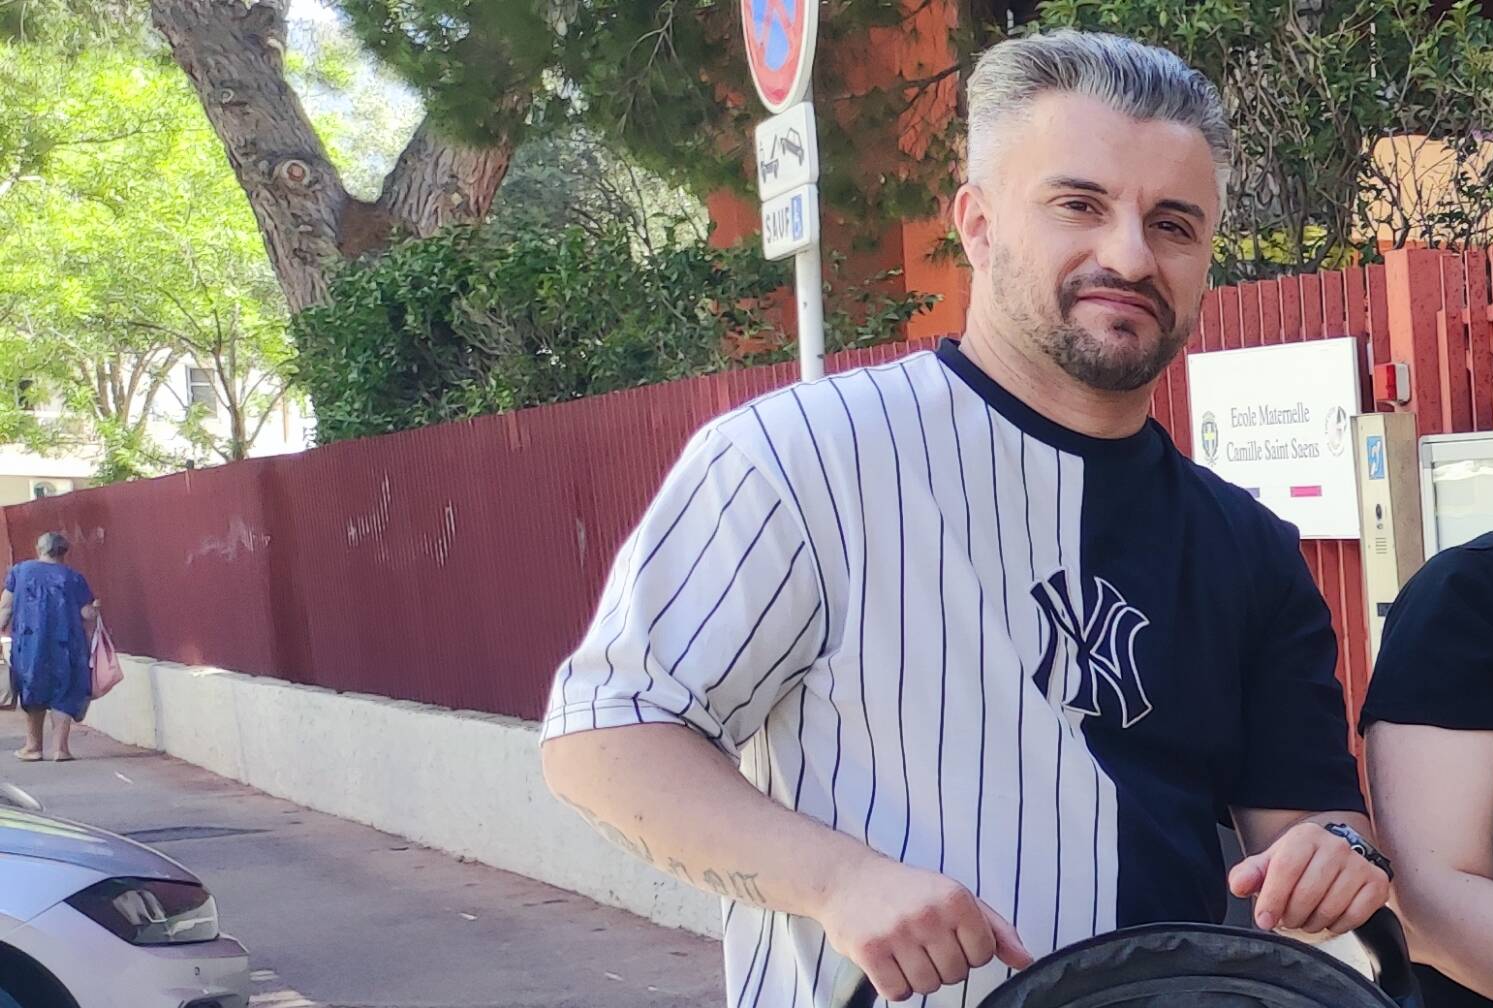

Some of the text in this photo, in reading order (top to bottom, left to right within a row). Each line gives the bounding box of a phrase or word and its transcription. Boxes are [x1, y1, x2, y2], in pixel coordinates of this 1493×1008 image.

[765, 207, 790, 243] SAUF
[1231, 402, 1311, 428] Ecole Maternelle
[1226, 441, 1263, 462] Camille
[1265, 439, 1289, 460] Saint
